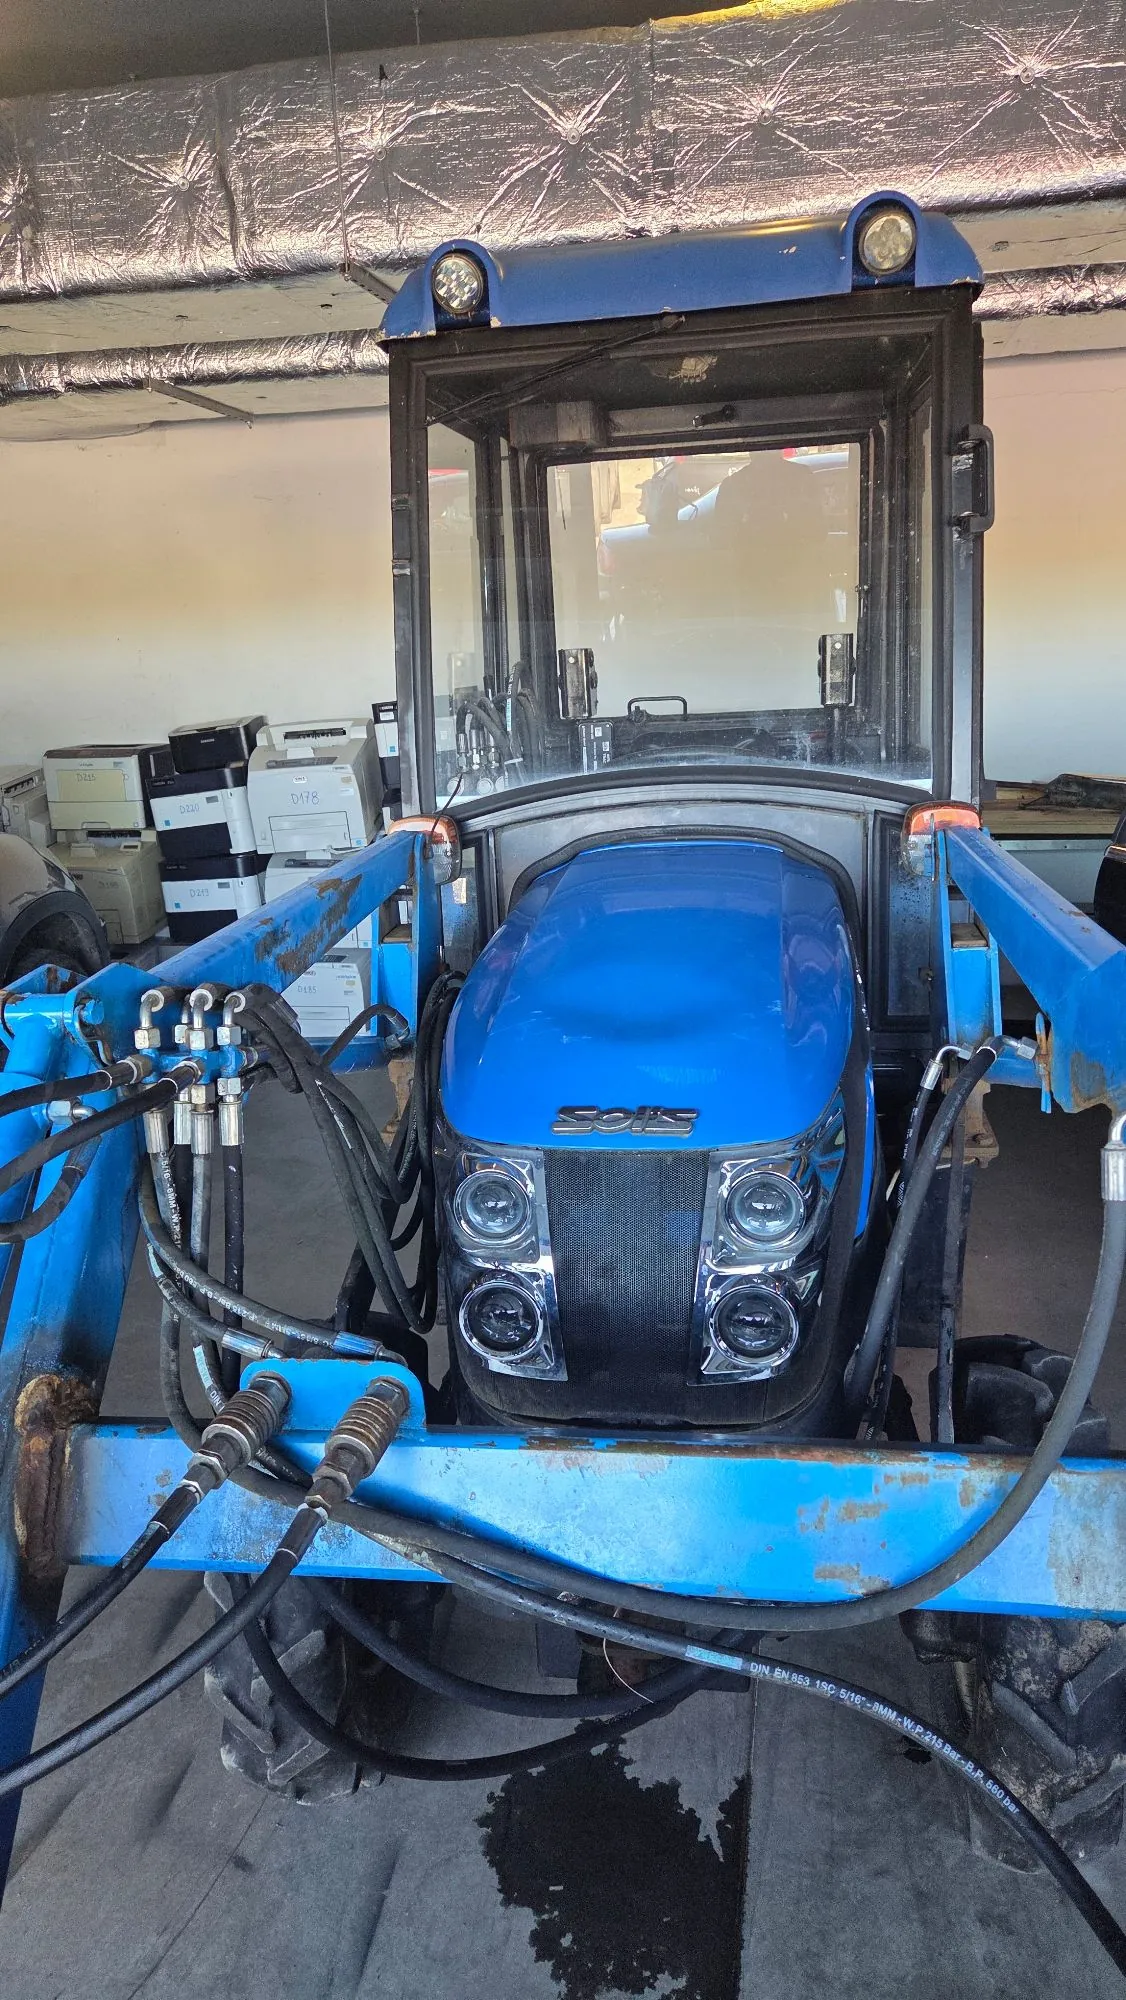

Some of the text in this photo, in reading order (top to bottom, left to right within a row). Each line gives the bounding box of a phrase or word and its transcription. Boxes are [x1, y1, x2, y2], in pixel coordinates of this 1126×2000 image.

[290, 790, 320, 805] D178
[749, 1662, 770, 1675] DIN
[774, 1666, 790, 1680] EN
[791, 1672, 810, 1686] 853
[815, 1680, 836, 1694] 1SC
[1002, 1795, 1021, 1814] bar
